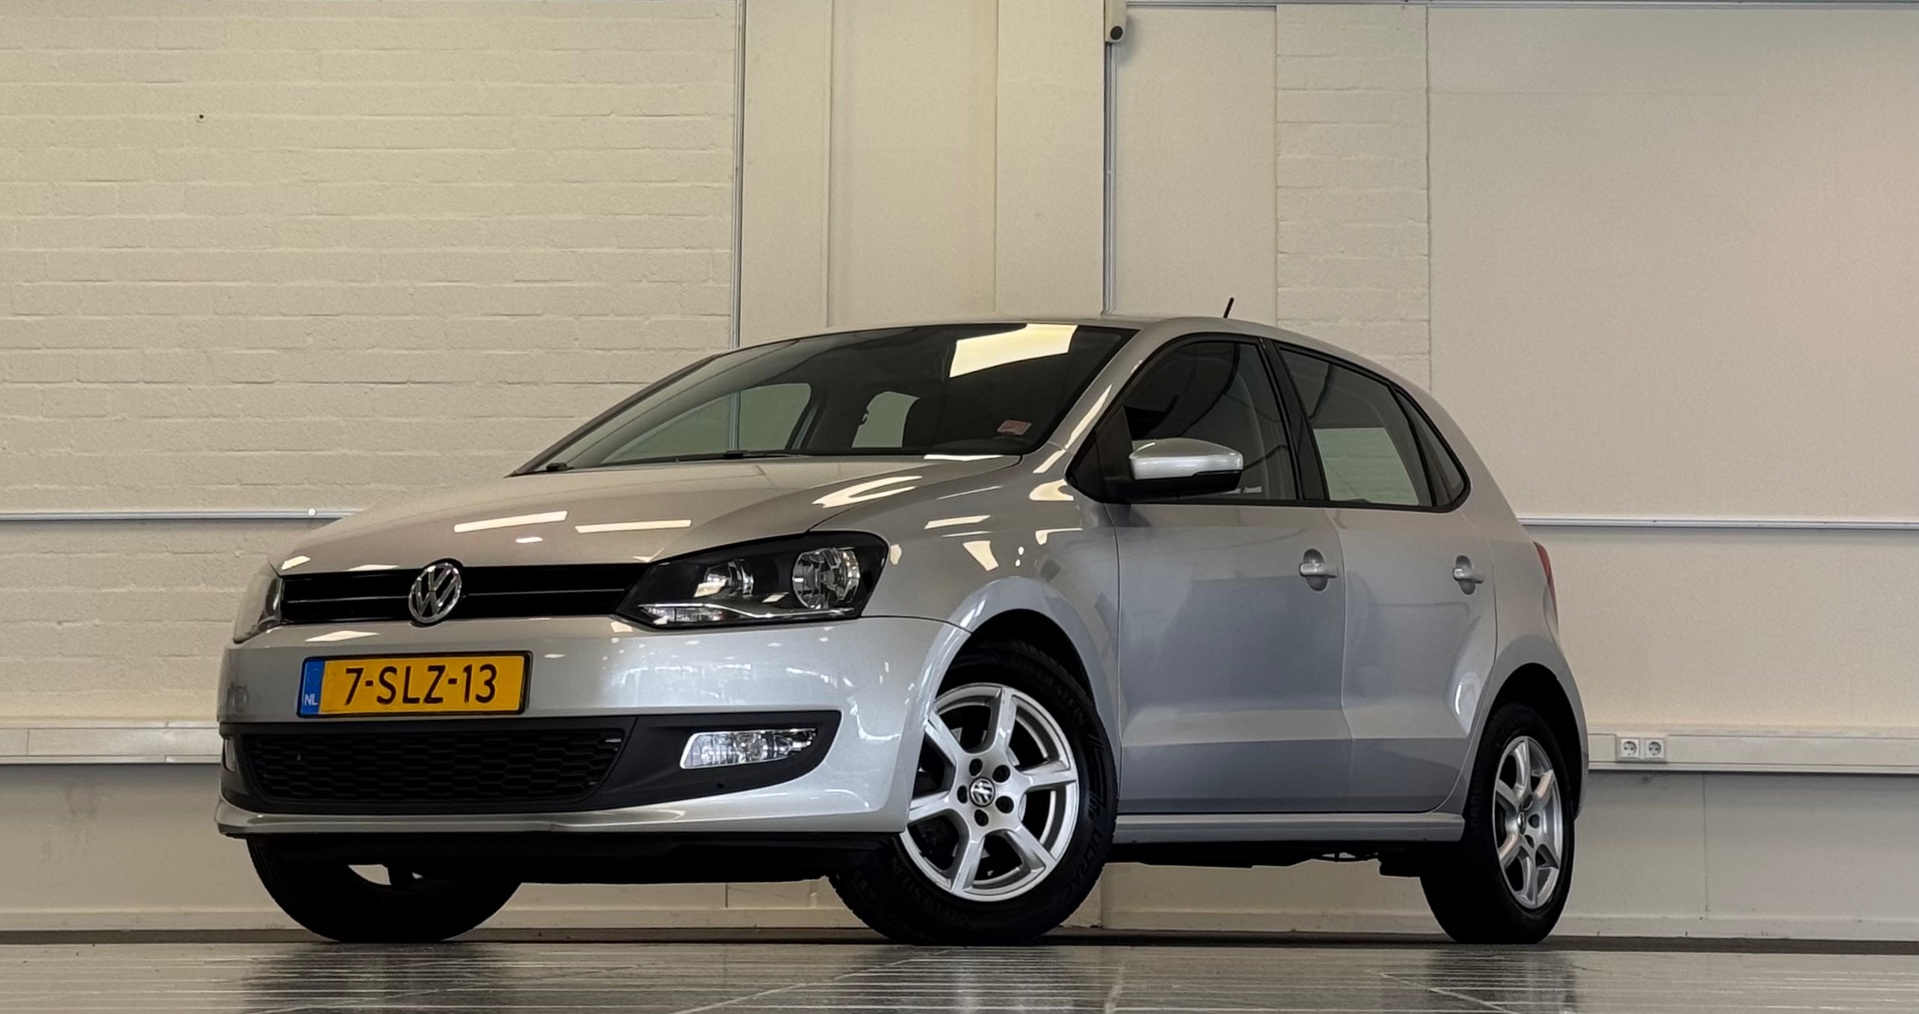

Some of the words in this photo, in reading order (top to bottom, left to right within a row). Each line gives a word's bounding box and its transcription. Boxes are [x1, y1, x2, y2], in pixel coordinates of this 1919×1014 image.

[409, 562, 461, 622] VW
[304, 692, 318, 706] NL
[344, 664, 497, 705] 7-SLZ-13
